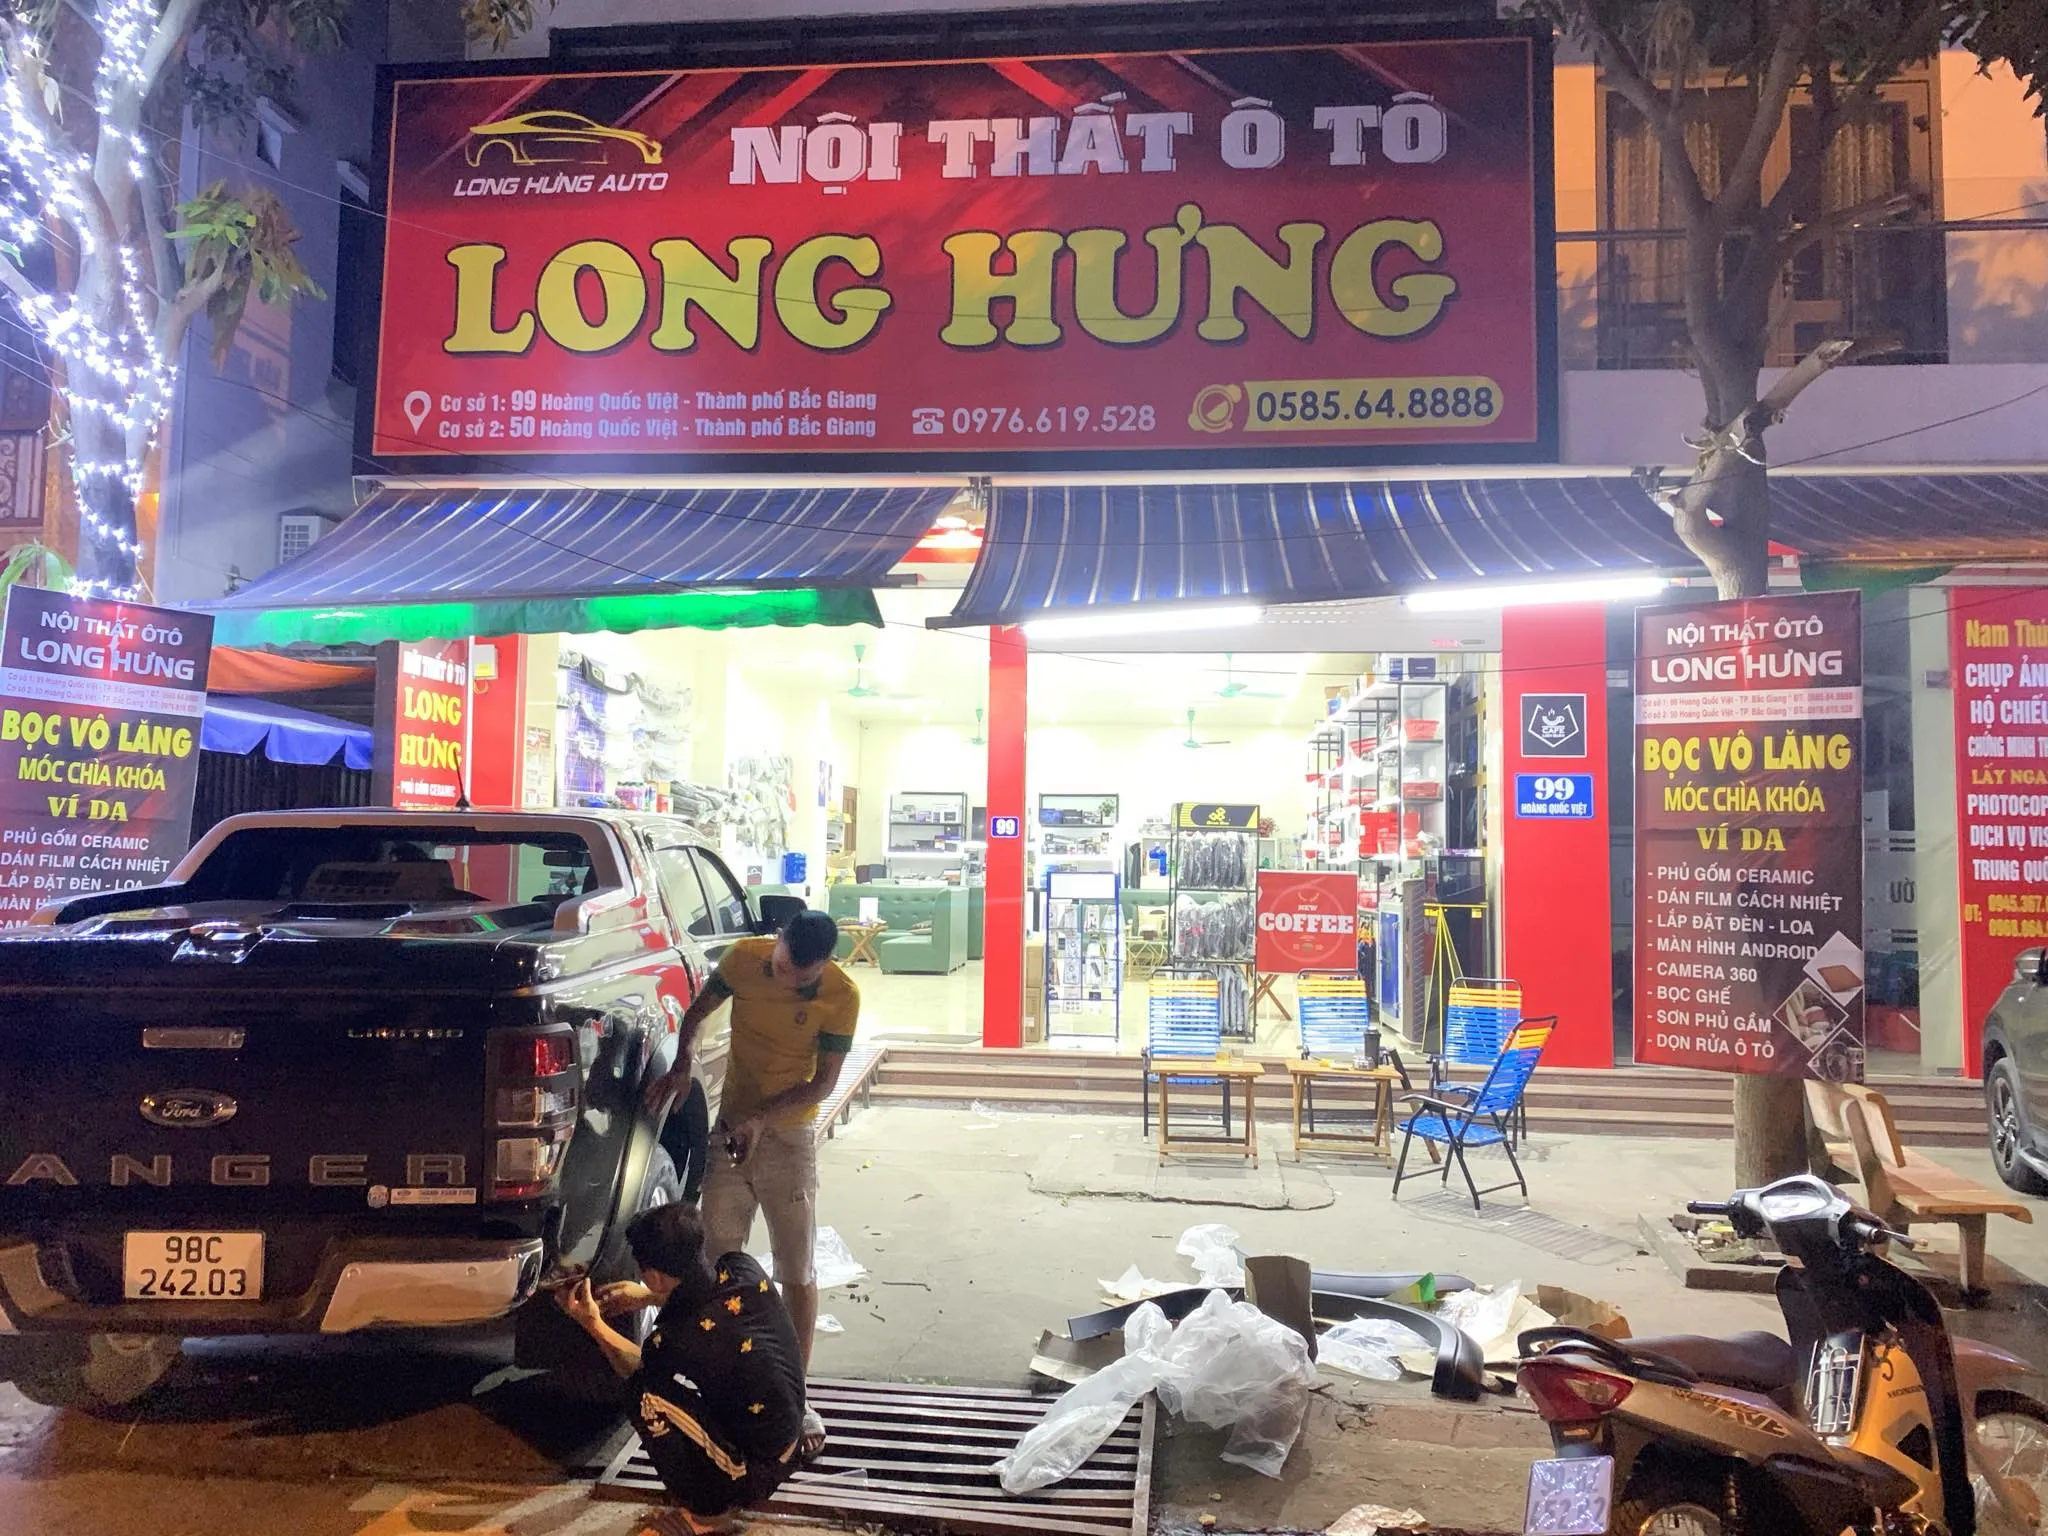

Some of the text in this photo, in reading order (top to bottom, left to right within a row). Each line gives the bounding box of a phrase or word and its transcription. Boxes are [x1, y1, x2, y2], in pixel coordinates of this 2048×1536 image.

[728, 90, 1447, 195] NỘI THẤT Ô TÔ
[454, 172, 669, 197] LONG HƯNG AUTO
[442, 201, 1458, 355] LONG HƯNG
[440, 386, 877, 414] Cơ sở 1: 99 Hoàng Quốc Việt Thành phố Bắc Giang
[1256, 386, 1495, 423] 0585.64.8888
[439, 412, 876, 440] Cơ sở 2: 50 Hoàng Quốc Việt Thành phố Bắc Giang
[951, 404, 1157, 435] 0976.619.528
[40, 611, 183, 646] NỘI THẤT ÔTÔ
[1667, 615, 1824, 648] NỘI THẤT ÔTÔ
[1966, 618, 2048, 648] Nam Thú
[20, 637, 196, 681] LONG HƯNG
[1651, 649, 1843, 683] LONG HƯNG
[1965, 663, 2014, 693] CHỤP
[403, 686, 462, 726] LONG
[1970, 694, 1995, 729] HỘ
[1, 709, 193, 758] BỌC VÔ LĂNG
[400, 733, 462, 771] HƯNG
[1643, 729, 1852, 780] BỌC VÔ LĂNG
[18, 754, 165, 791] MÓC CHÌA KHÓA
[1971, 763, 2048, 785] LẤY NGA
[1534, 777, 1575, 801] 99
[1664, 780, 1826, 812] MÓC CHÌA KHÓA
[47, 795, 129, 822] VÍ DA
[1967, 794, 2048, 817] PHOTOCOP
[3, 827, 150, 851] PHỦ GỐM CERAMIC
[995, 818, 1015, 835] 99
[1696, 822, 1786, 851] VÍ DA
[1970, 825, 2003, 850] DỊCH
[2007, 825, 2025, 851] VỤ
[1, 849, 170, 875] DÁN FILM CÁCH NHIỆT
[1657, 862, 1815, 885] PHỦ GỐM CERAMIC
[1972, 859, 2020, 881] TRUNG
[0, 869, 29, 888] LẮP
[33, 871, 66, 891] ĐẶT
[69, 875, 102, 891] ĐÈN
[1657, 886, 1843, 914] DÁN FILM CÁCH NHIỆT
[1259, 912, 1354, 934] COFFEE
[1657, 908, 1815, 936] LẮP ĐẶT ĐÈN LOA
[1657, 936, 1818, 961] MÀN HÌNH ANDROID
[1657, 962, 1757, 983] CAMERA 360
[1657, 985, 1732, 1005] BỌC GHẾ
[1657, 1009, 1772, 1033] SƠN PHỦ GẦM
[1657, 1034, 1774, 1058] DỌN RỬA Ô TÔ
[162, 1101, 202, 1118] Ford
[165, 1236, 222, 1264] 98C
[140, 1269, 247, 1297] 242.03
